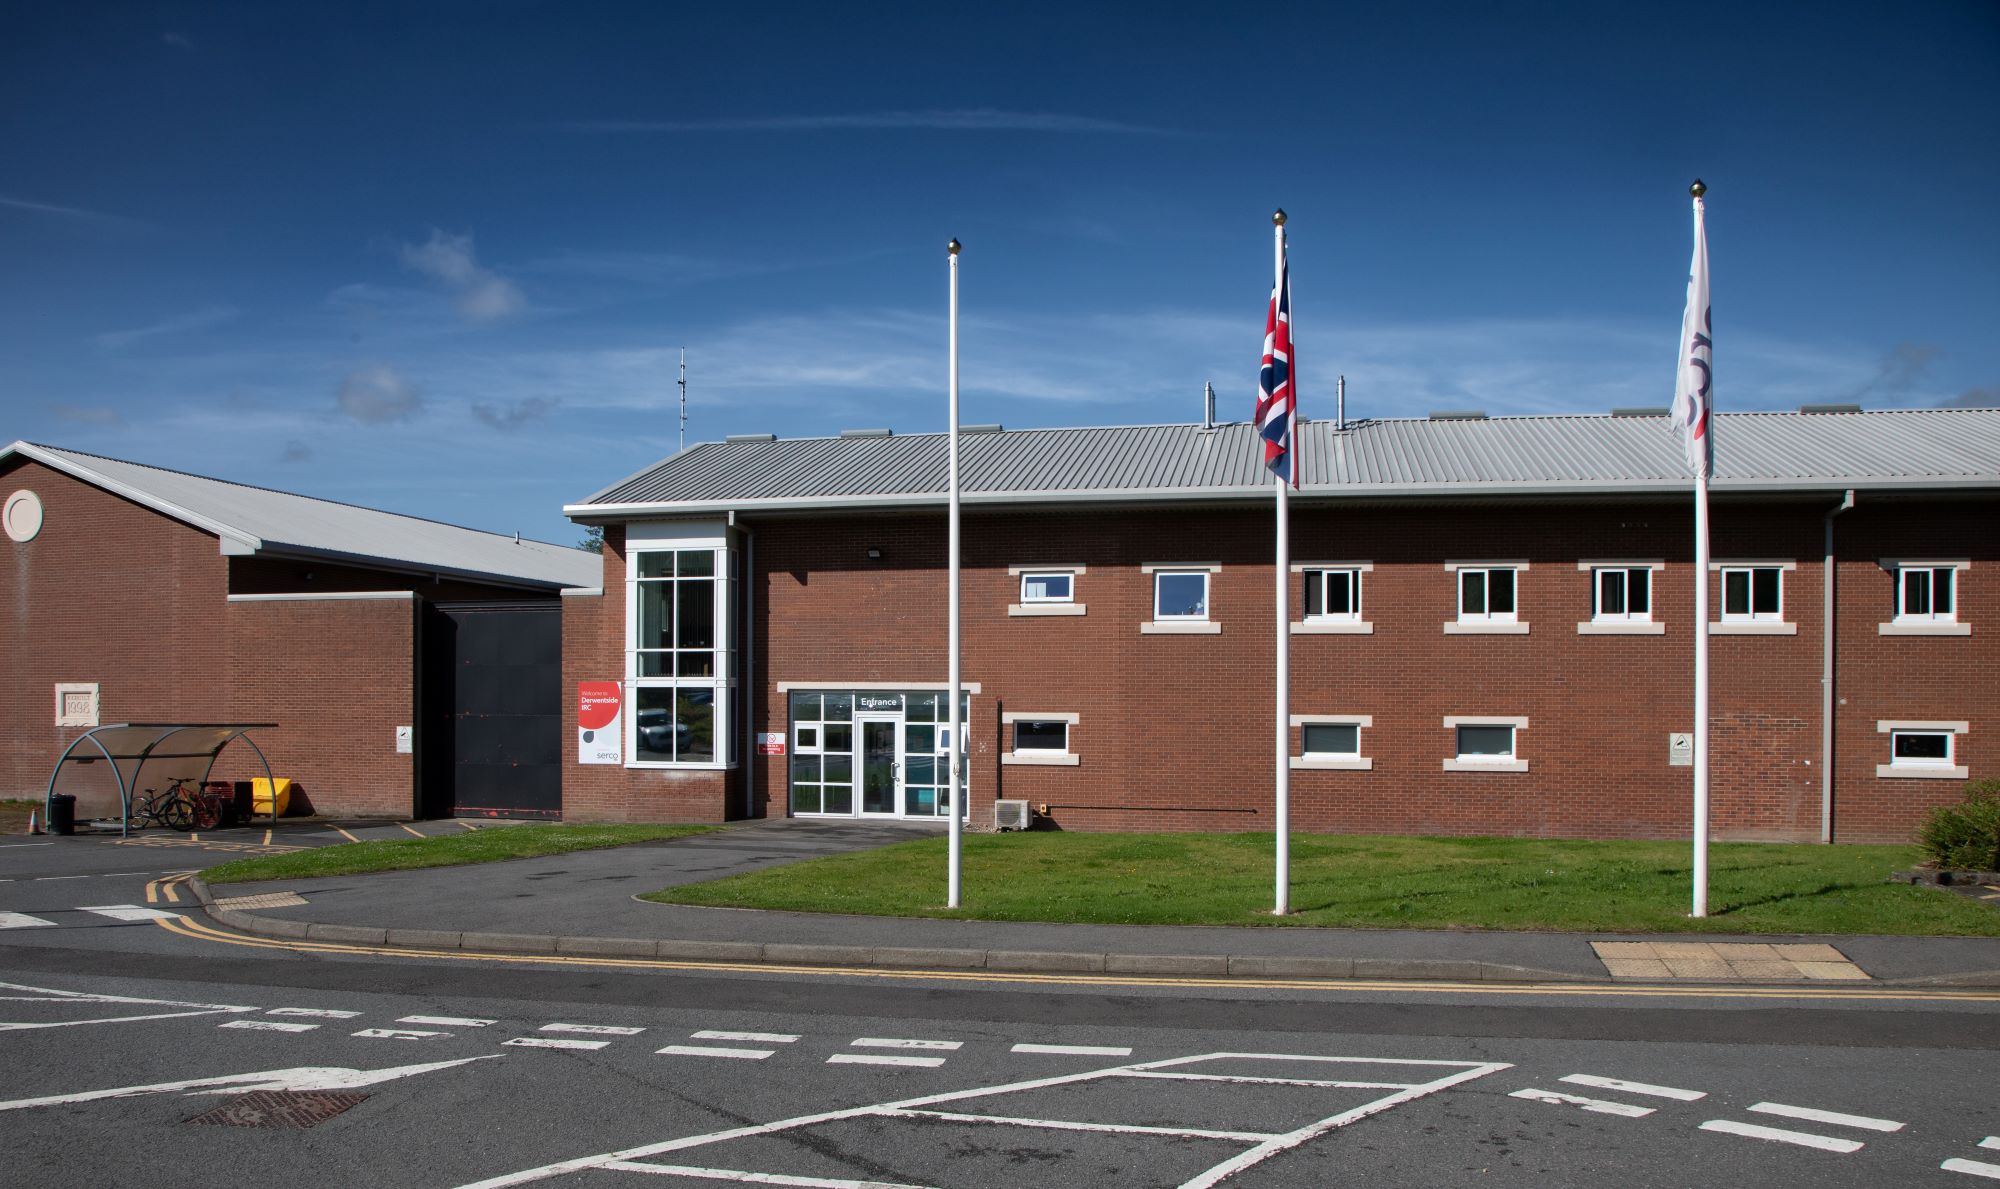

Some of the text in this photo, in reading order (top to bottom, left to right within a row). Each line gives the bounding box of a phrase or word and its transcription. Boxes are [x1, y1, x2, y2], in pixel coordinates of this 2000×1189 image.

[581, 696, 619, 704] Derwentside
[861, 697, 897, 706] Entrance
[67, 701, 90, 714] 1998
[596, 752, 619, 761] serco
